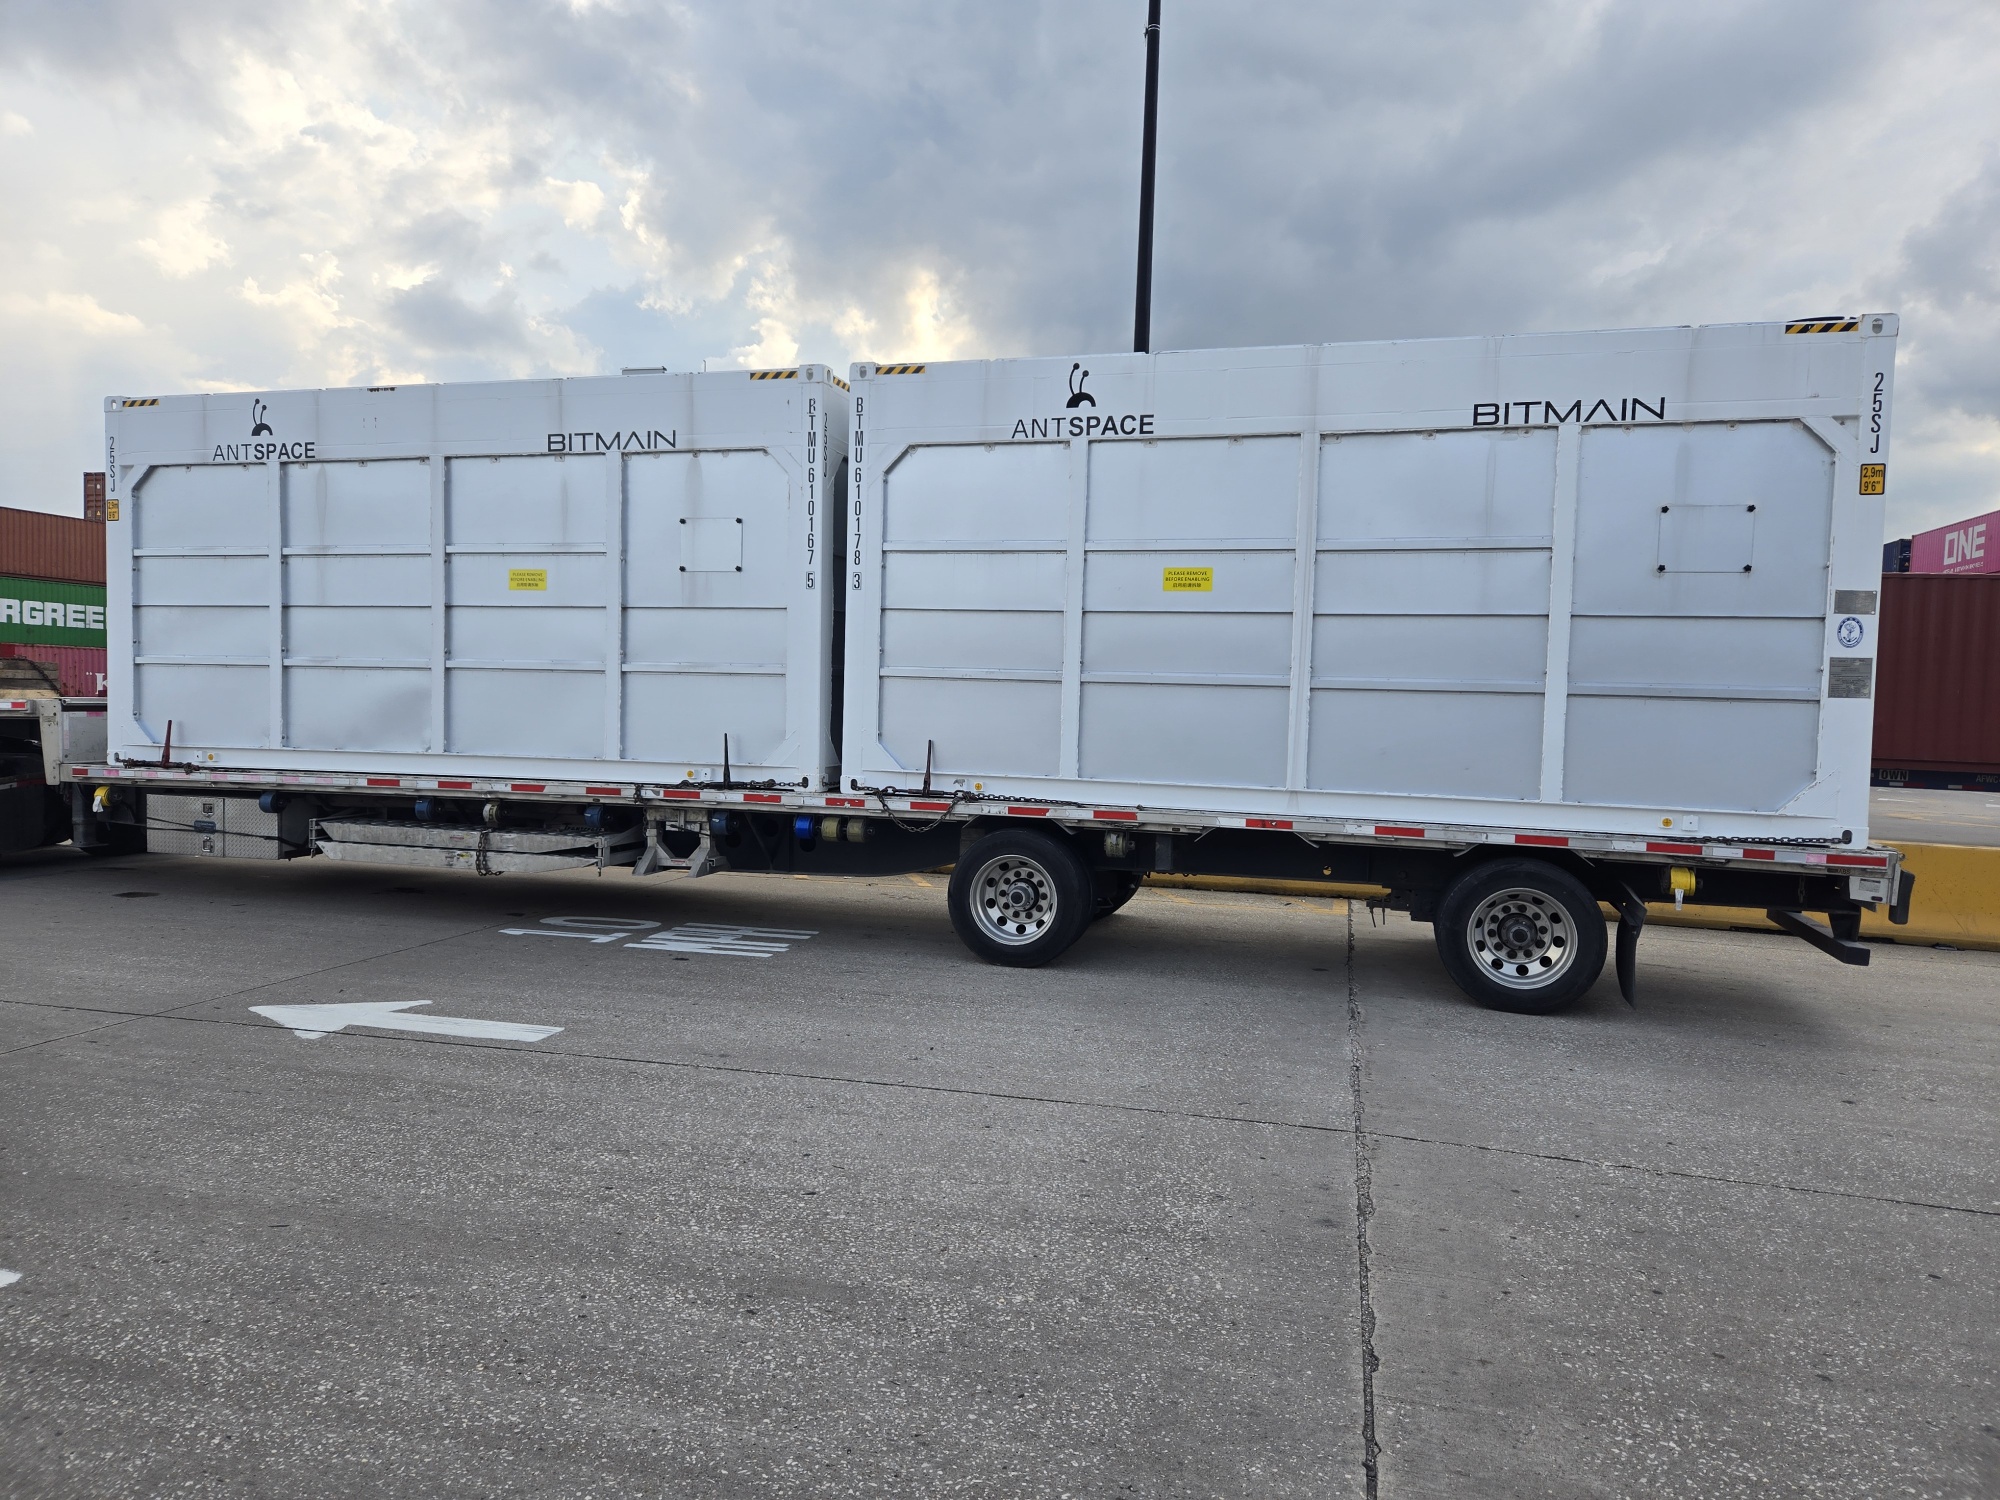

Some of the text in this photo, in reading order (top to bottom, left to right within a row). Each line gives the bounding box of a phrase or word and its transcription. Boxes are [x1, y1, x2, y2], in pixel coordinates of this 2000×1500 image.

[1012, 414, 1154, 439] ANTSPACE
[1473, 397, 1665, 426] BITMAIN
[1870, 372, 1884, 454] 25SJ
[213, 442, 316, 461] ANTSPACE
[547, 430, 676, 452] BITMAIN
[853, 397, 863, 590] BTMU 610178 3
[806, 467, 815, 565] 610167
[1944, 523, 1986, 566] ONE
[806, 572, 815, 589] 5
[0, 598, 107, 630] RGREE
